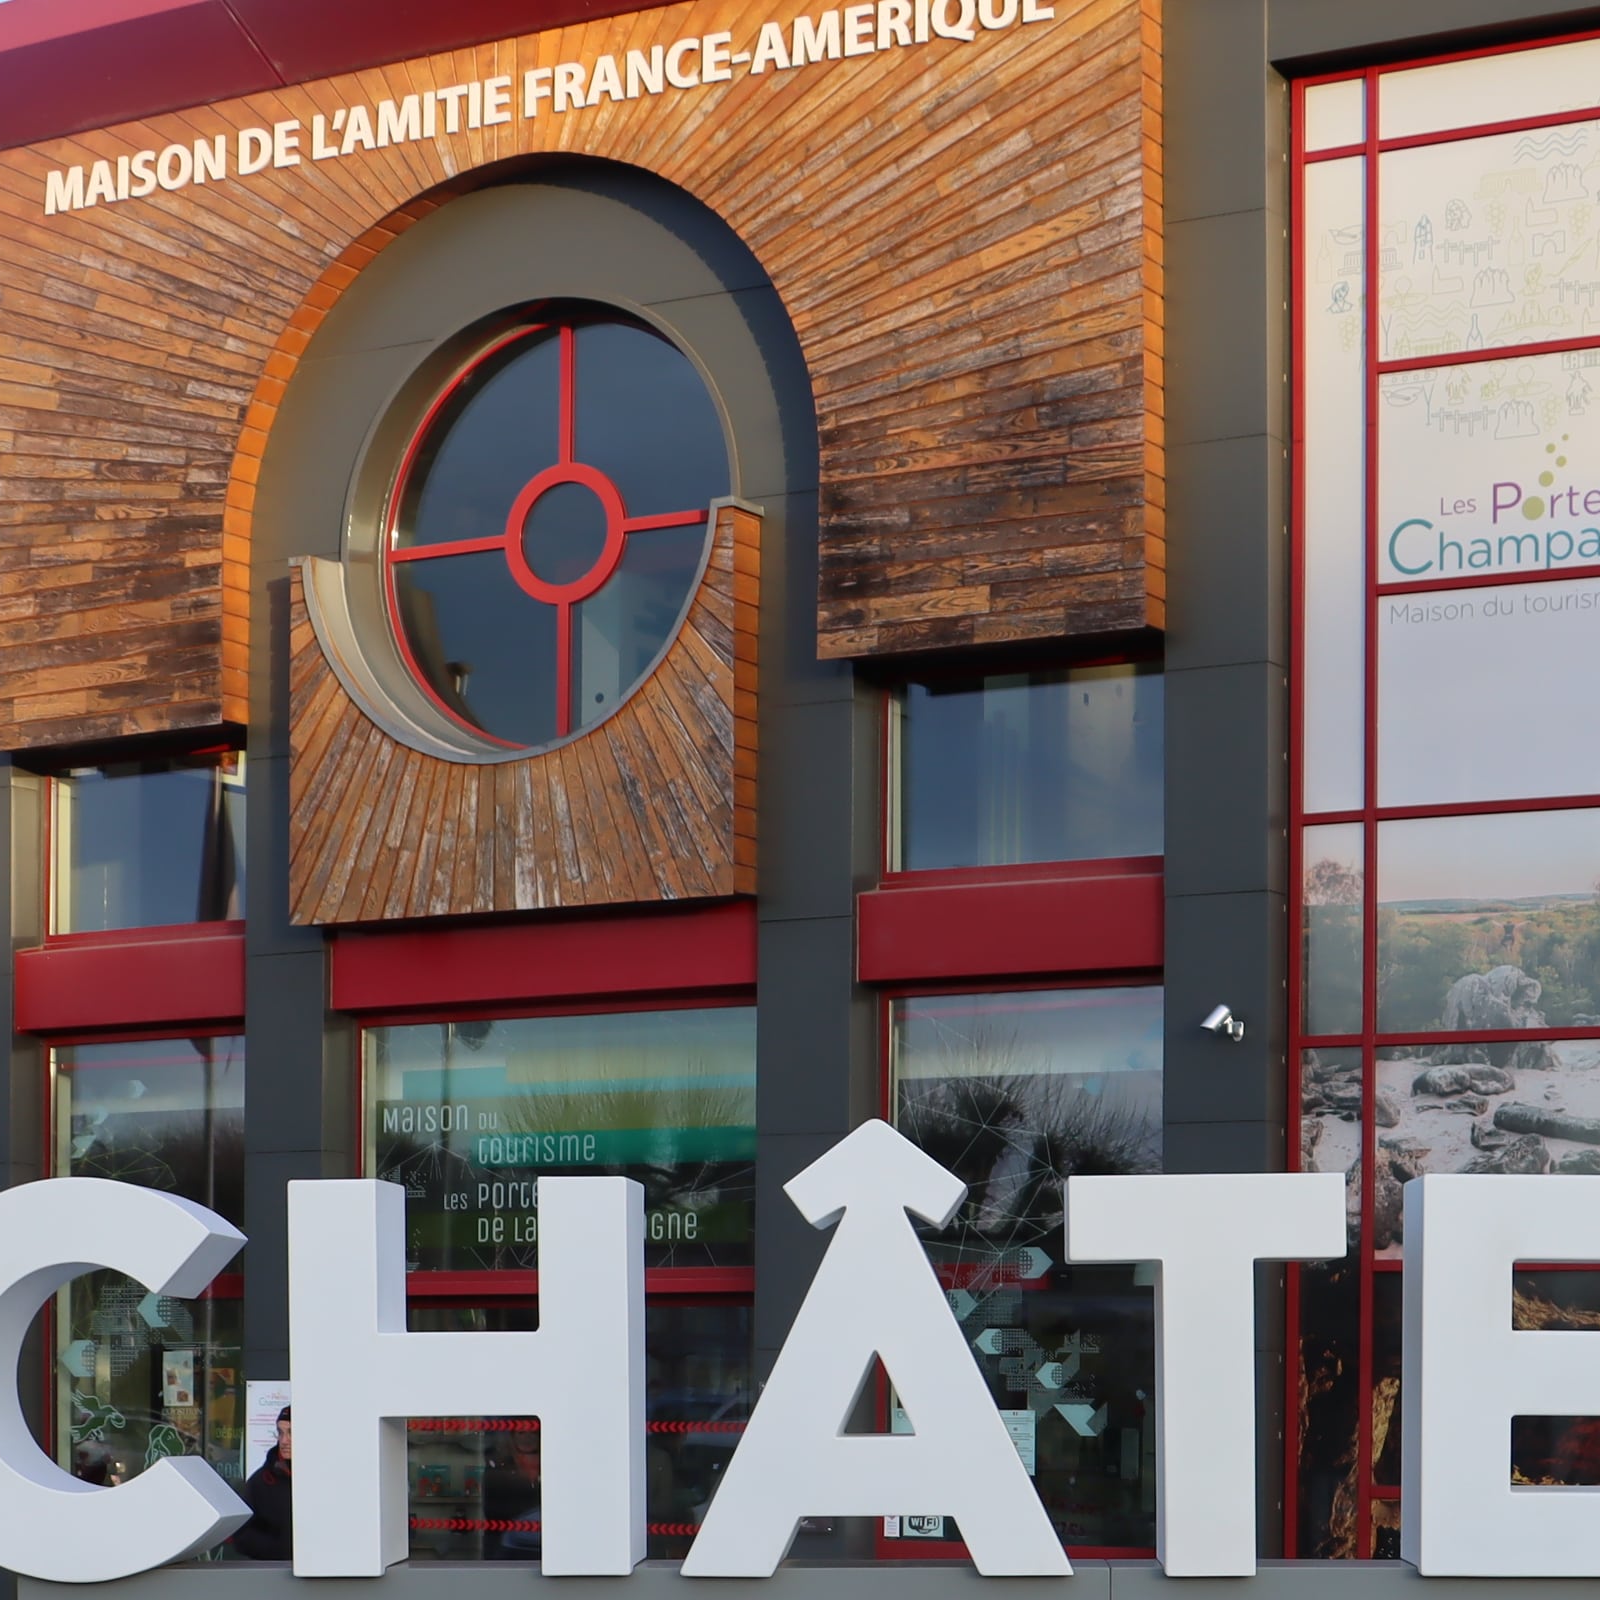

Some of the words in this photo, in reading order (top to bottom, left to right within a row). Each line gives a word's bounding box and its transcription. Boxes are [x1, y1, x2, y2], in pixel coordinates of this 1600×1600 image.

[45, 134, 226, 216] MAISON
[238, 119, 301, 176] DE
[312, 75, 512, 161] L'AMITIE
[523, 0, 1055, 118] FRANCE-AMERIQUE
[1440, 497, 1477, 516] Les
[1390, 602, 1474, 625] Maison
[1483, 594, 1514, 617] du
